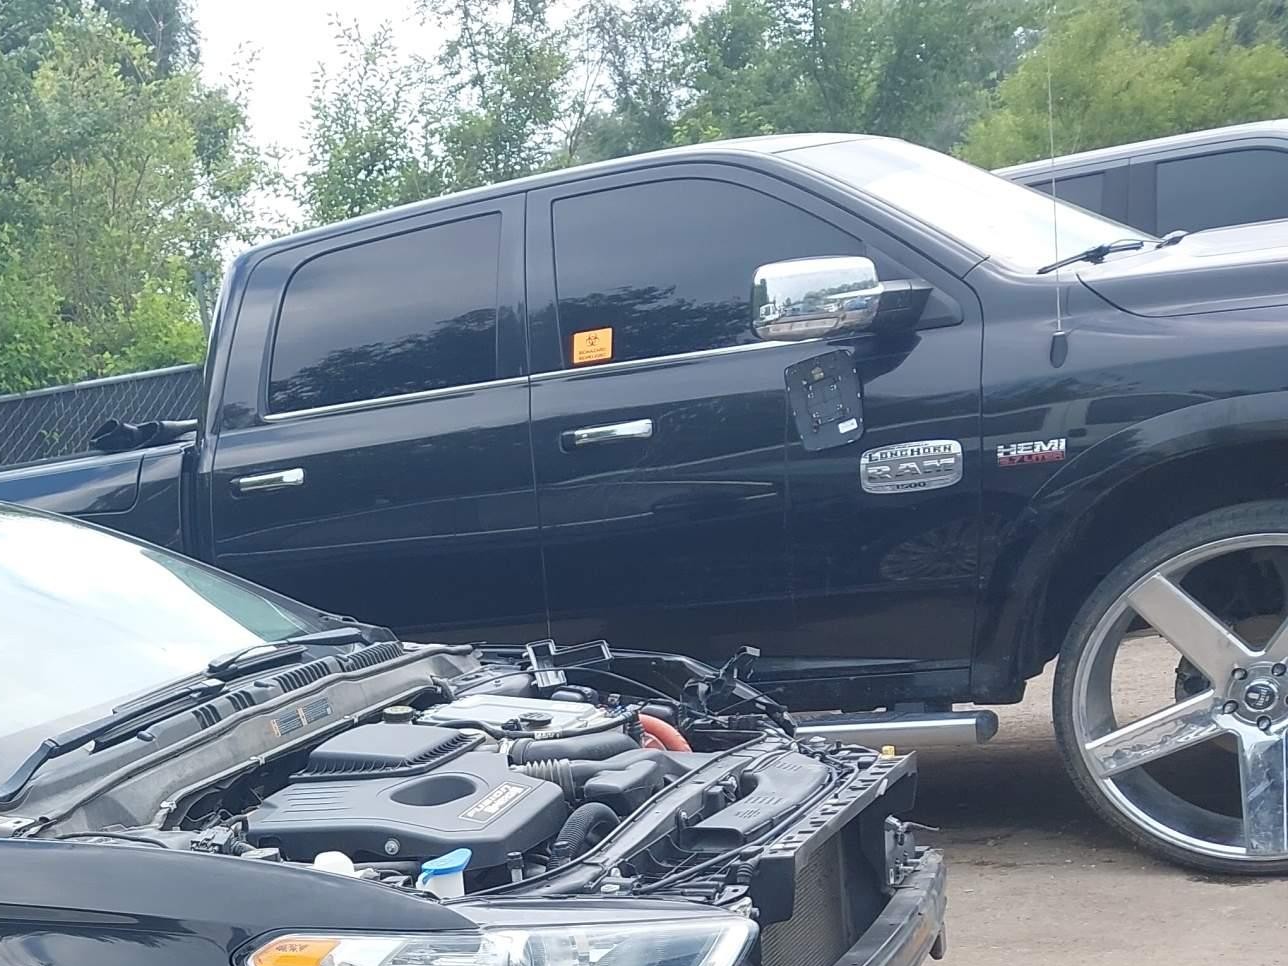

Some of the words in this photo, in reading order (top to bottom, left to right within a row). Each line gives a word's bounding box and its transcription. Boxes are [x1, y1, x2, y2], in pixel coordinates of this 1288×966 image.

[868, 445, 952, 462] LONGHORN
[997, 439, 1066, 457] HEMI
[867, 457, 955, 480] RAM
